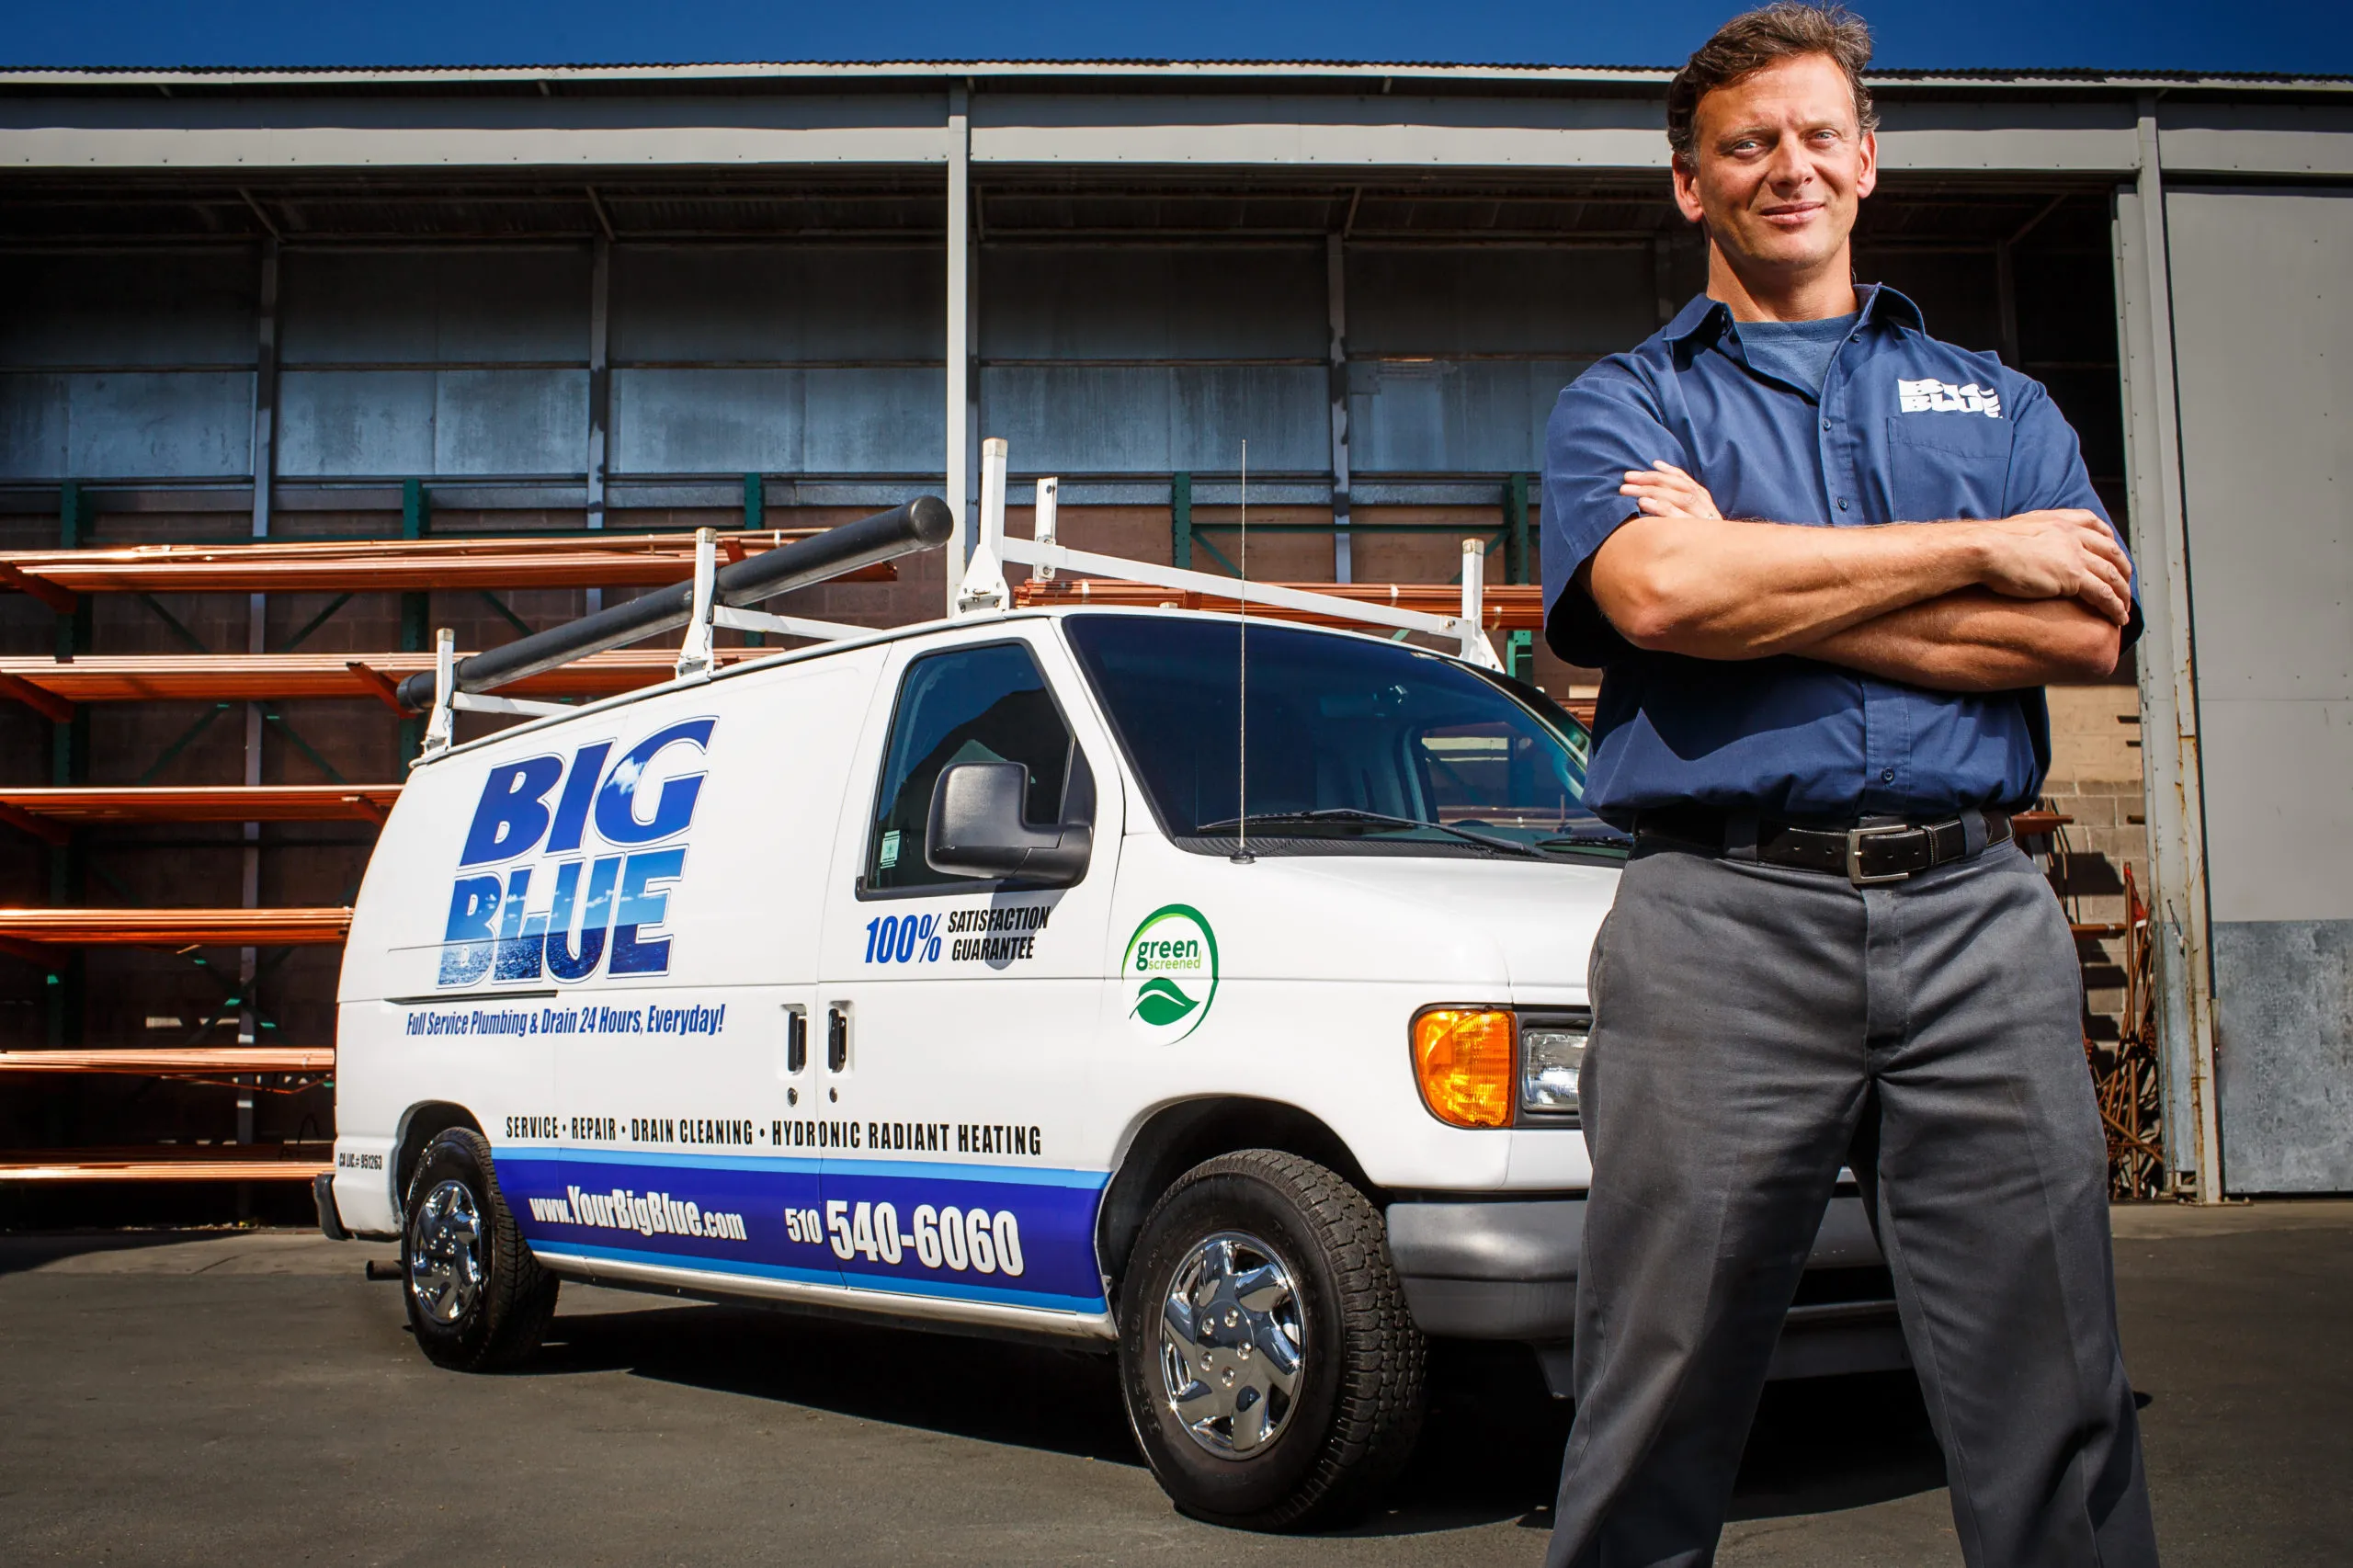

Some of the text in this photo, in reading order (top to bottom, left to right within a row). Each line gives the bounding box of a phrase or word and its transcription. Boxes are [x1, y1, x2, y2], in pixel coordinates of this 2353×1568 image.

[1900, 393, 2003, 419] BLUE
[457, 715, 720, 870] BIG
[436, 844, 689, 989] BLUE
[948, 905, 1051, 933] SATISFACTION
[865, 913, 942, 964] 100%
[951, 936, 1035, 961] GUARANTEE
[1136, 939, 1199, 971] green
[1148, 950, 1201, 970] screened
[406, 1004, 726, 1038] Full Service Plumbing & Drain 24 Hours, Everyday!
[506, 1116, 1041, 1155] SERVICE REPAIR DRAIN CLEANING HYDRONIC RADIANT HEATING
[529, 1185, 747, 1241] www.YourBigBlue.com
[785, 1200, 1024, 1277] 510 540-6060
